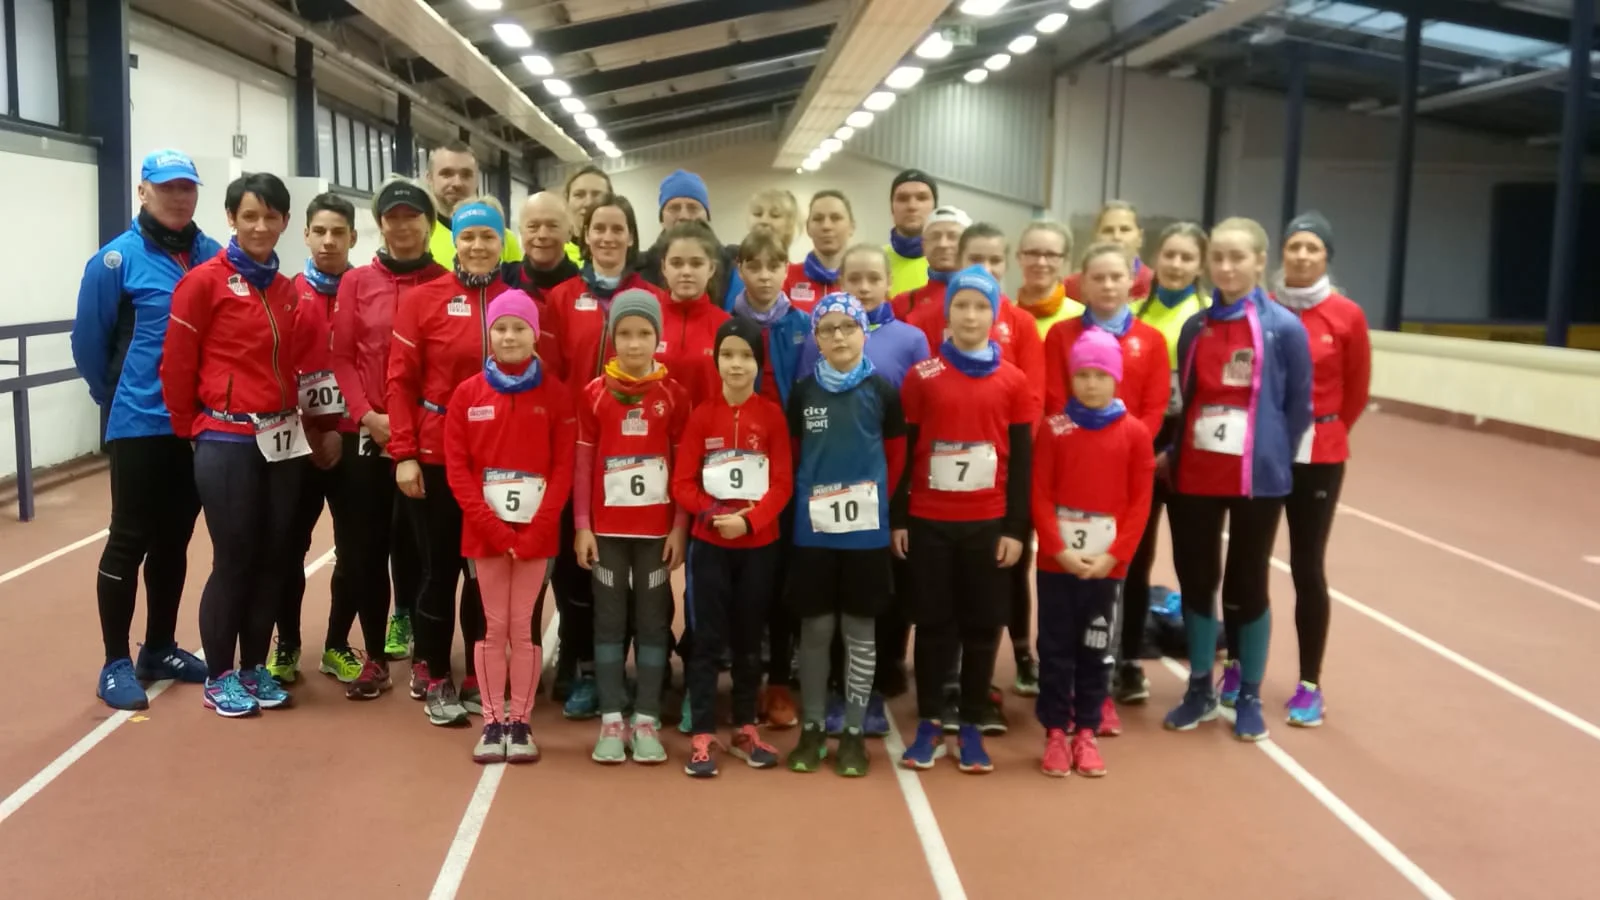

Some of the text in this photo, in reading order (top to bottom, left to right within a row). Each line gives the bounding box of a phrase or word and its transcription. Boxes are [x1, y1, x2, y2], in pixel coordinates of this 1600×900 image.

[307, 387, 344, 409] 207
[273, 431, 292, 452] 17
[1214, 423, 1227, 441] 4
[729, 467, 744, 489] 9
[955, 461, 970, 482] 7
[630, 474, 646, 496] 6
[505, 490, 521, 512] 5
[829, 500, 859, 522] 10
[1072, 529, 1087, 550] 3
[1084, 628, 1108, 650] HB
